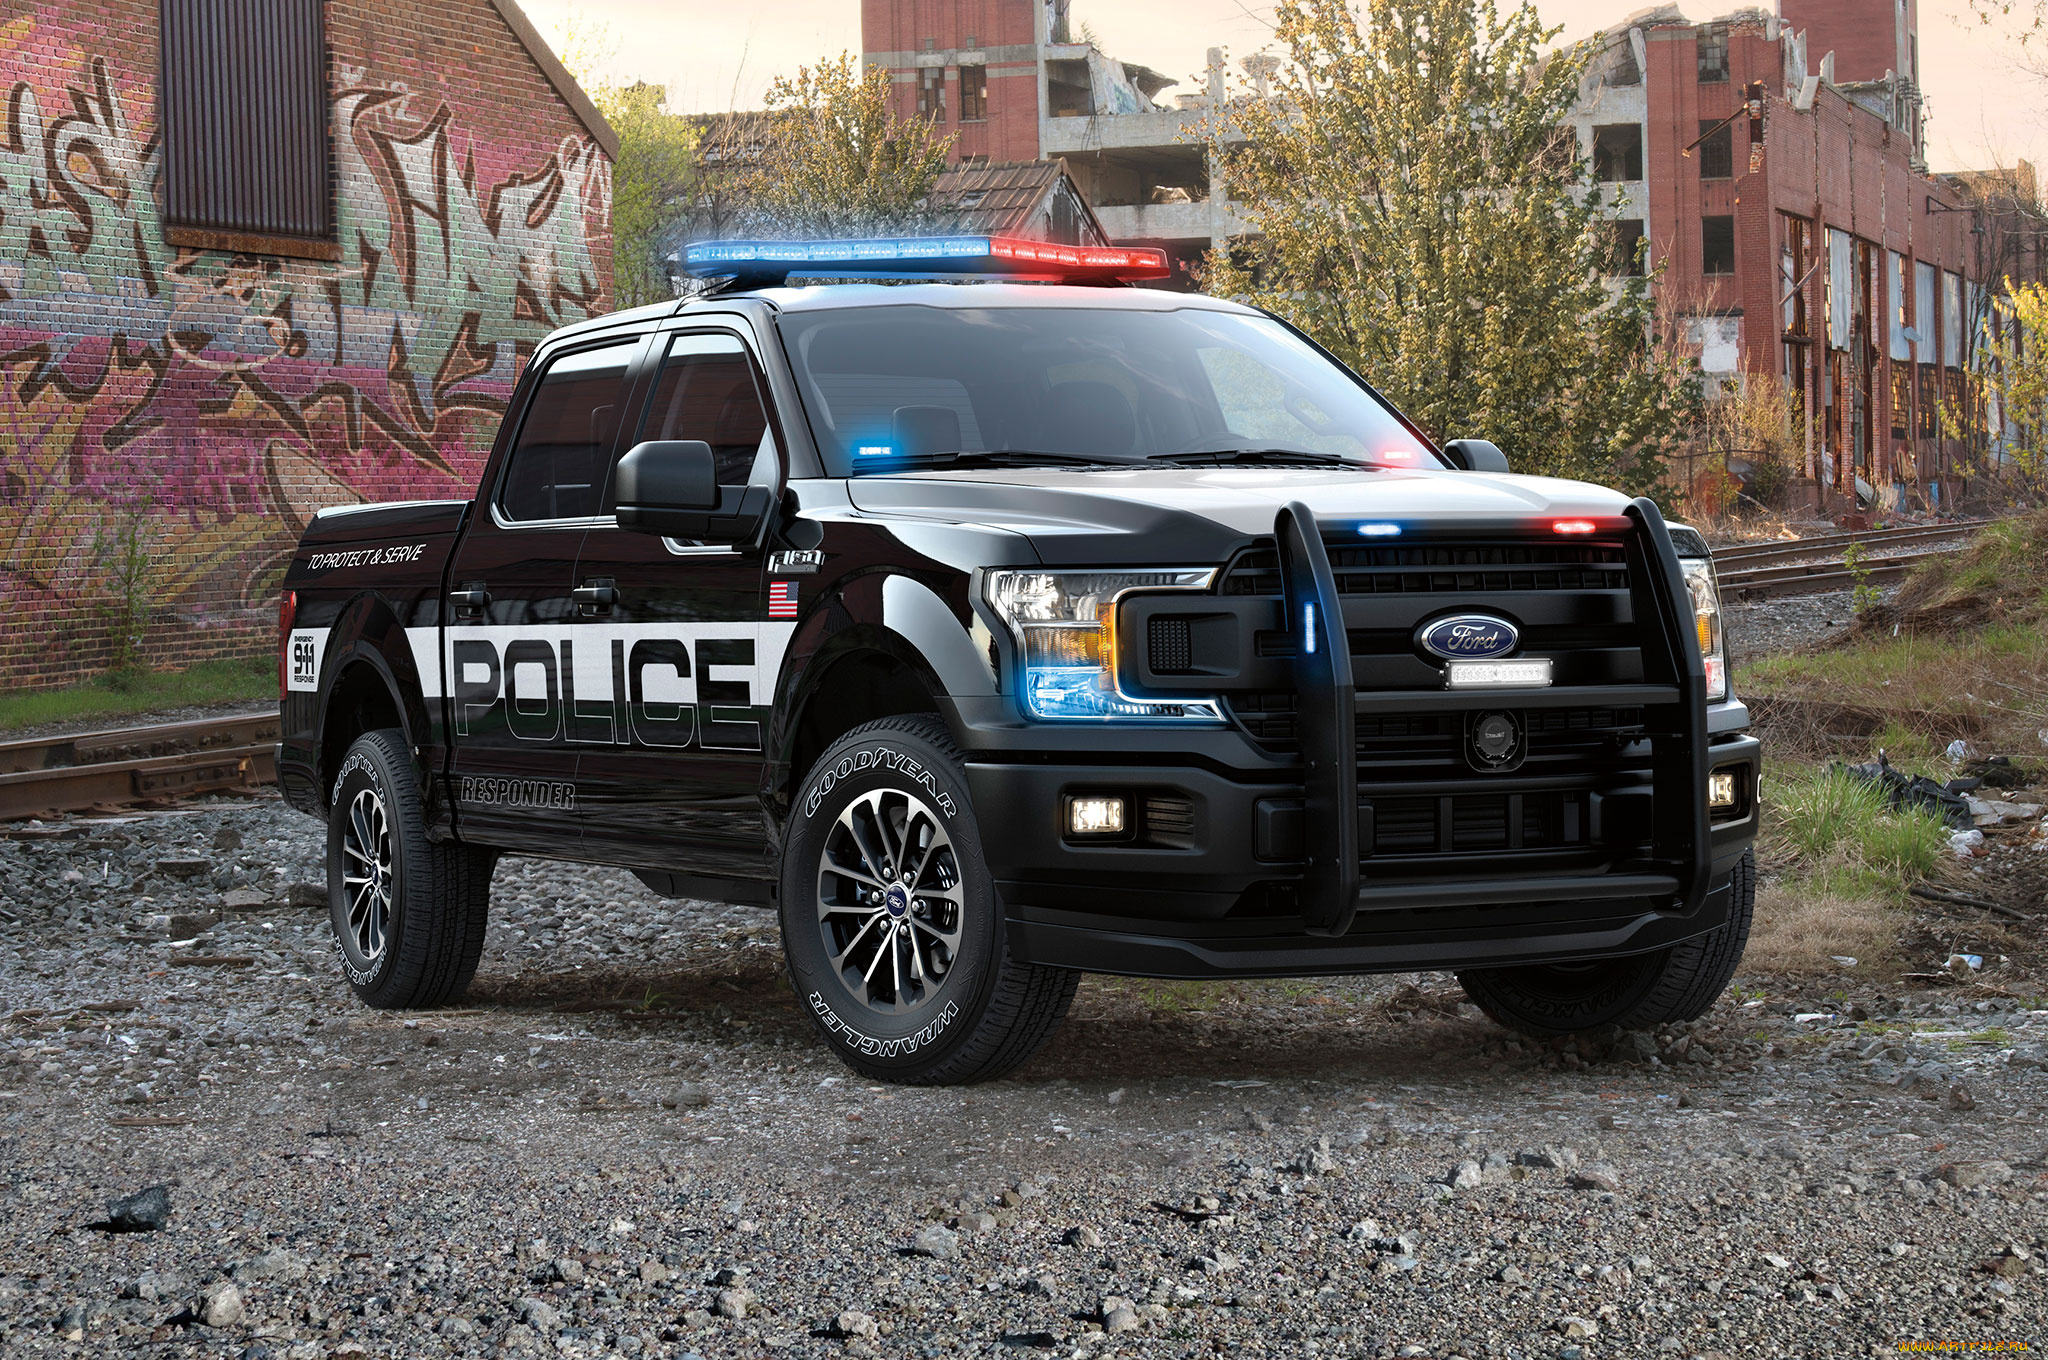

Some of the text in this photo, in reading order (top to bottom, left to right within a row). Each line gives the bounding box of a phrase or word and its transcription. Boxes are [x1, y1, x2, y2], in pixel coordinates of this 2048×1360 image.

[307, 543, 427, 570] TO PROTECT & SERVE
[1447, 624, 1499, 651] Ford
[294, 675, 315, 683] RESPONSE
[453, 638, 762, 752] POLICE
[331, 753, 387, 806] GOODYEAR
[460, 776, 576, 811] RESPONDER
[805, 747, 958, 819] GOODYEAR
[808, 990, 960, 1058] WRANGLER
